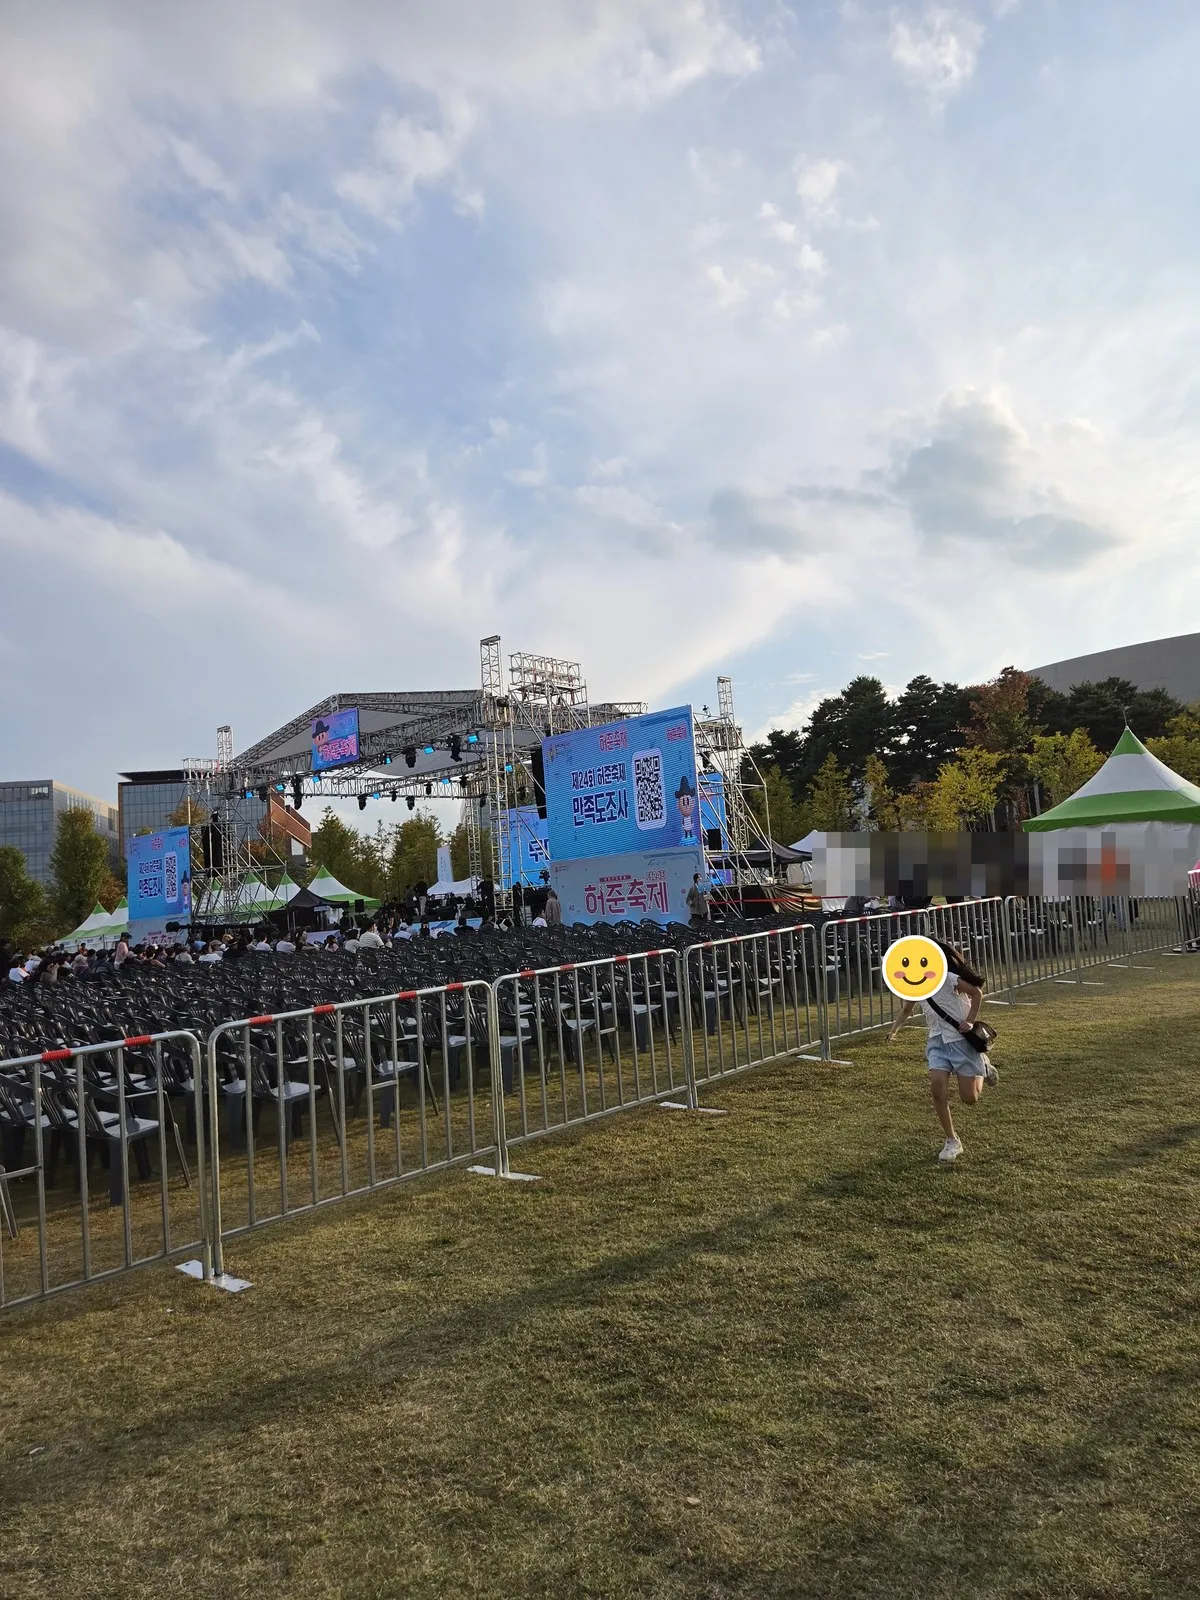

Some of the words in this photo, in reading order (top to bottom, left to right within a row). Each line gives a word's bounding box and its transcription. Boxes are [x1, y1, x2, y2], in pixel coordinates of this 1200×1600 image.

[599, 728, 628, 752] 허준축제
[571, 768, 596, 789] 제24회
[596, 762, 626, 785] 허준축제
[572, 788, 629, 827] 만족도조사
[139, 876, 162, 898] 만족도조사
[584, 878, 669, 916] 허준축제
